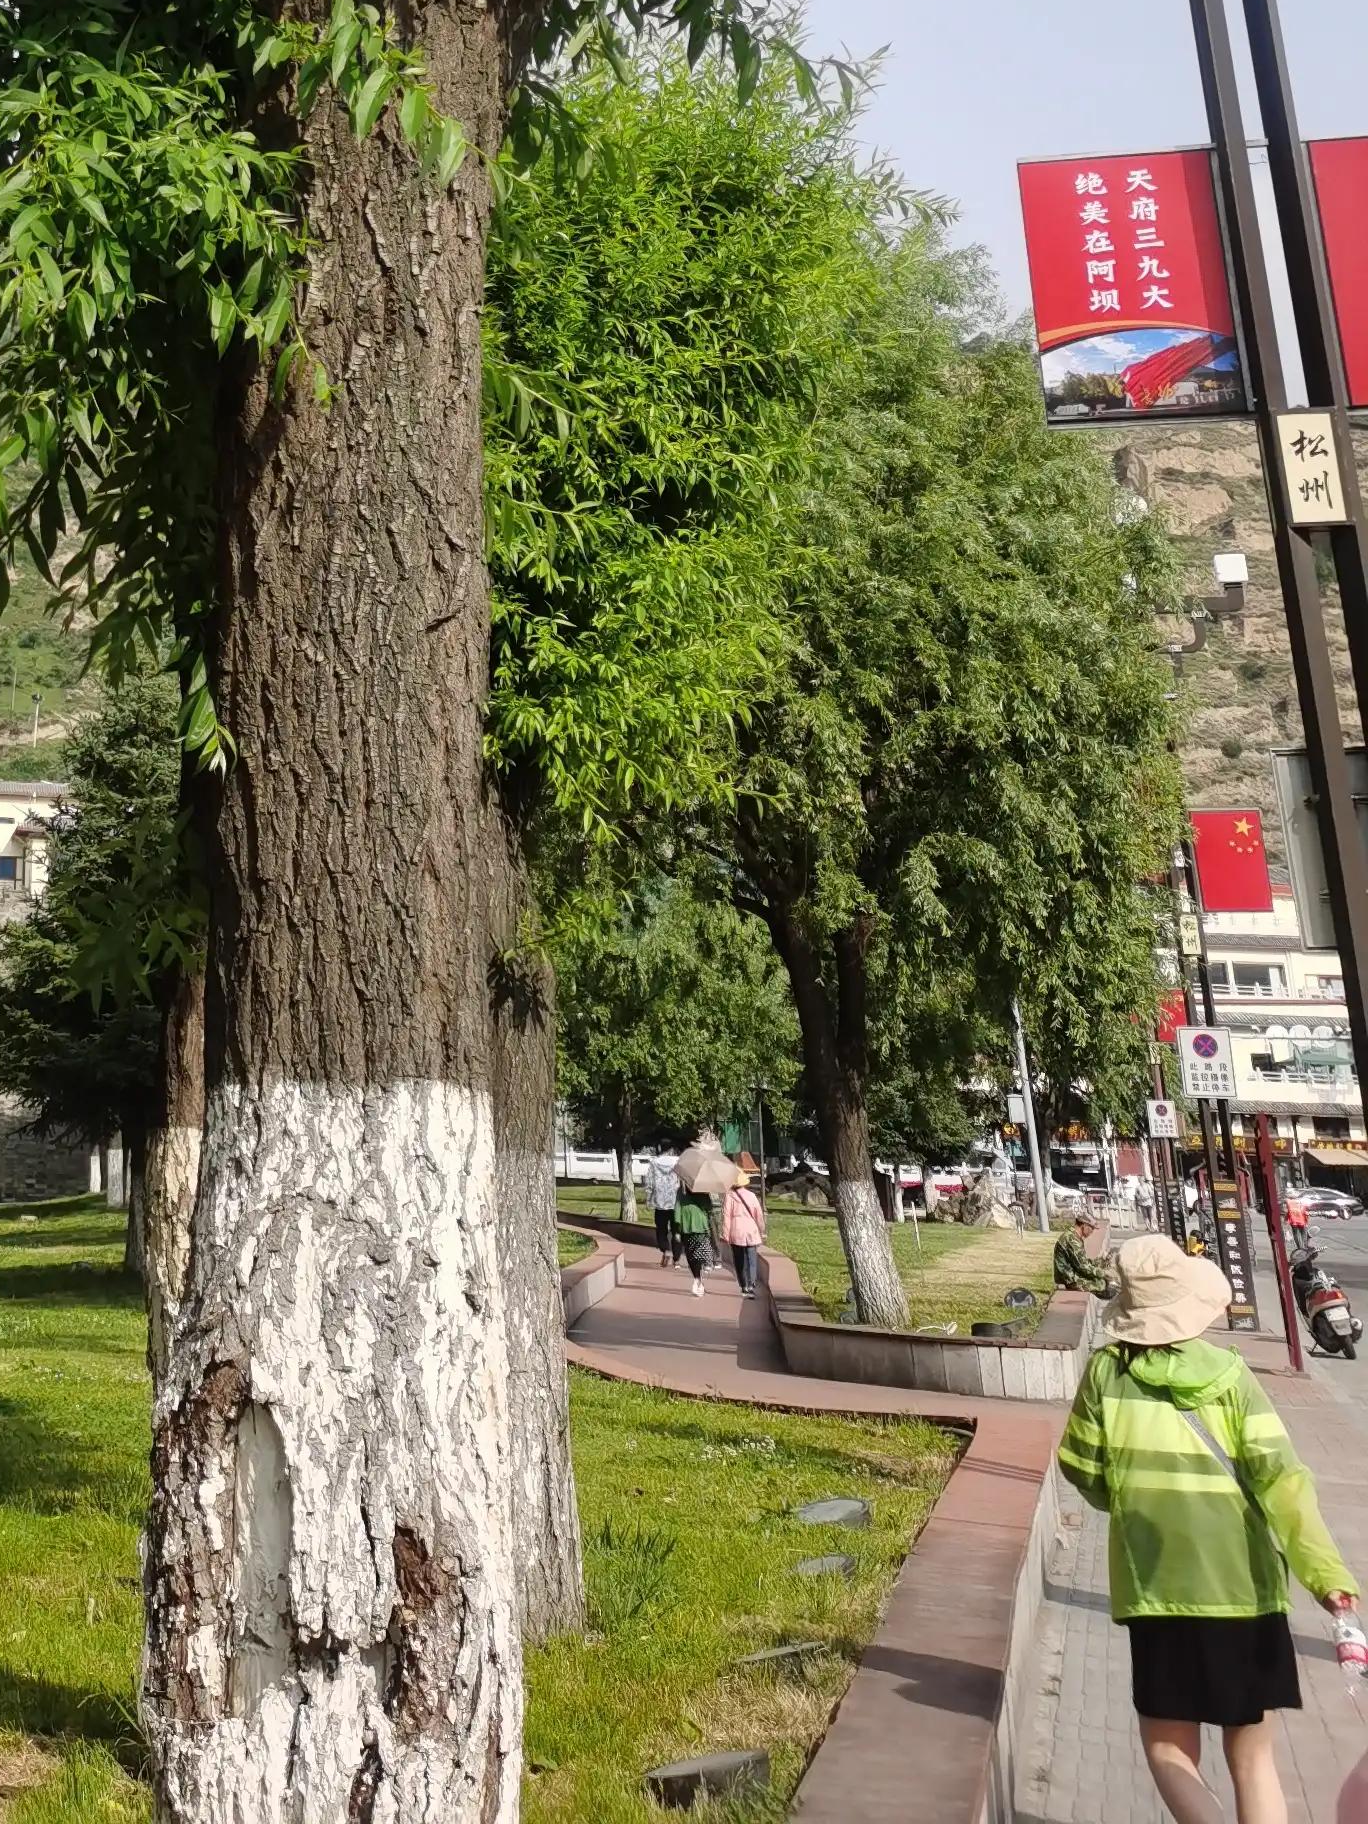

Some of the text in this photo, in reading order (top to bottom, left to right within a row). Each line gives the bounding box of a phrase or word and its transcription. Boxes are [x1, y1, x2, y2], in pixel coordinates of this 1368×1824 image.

[1074, 172, 1121, 313] 绝美在阿坝
[1124, 168, 1175, 310] 天府三九大
[1289, 429, 1333, 509] 松州
[1192, 1083, 1231, 1093] 禁止停车
